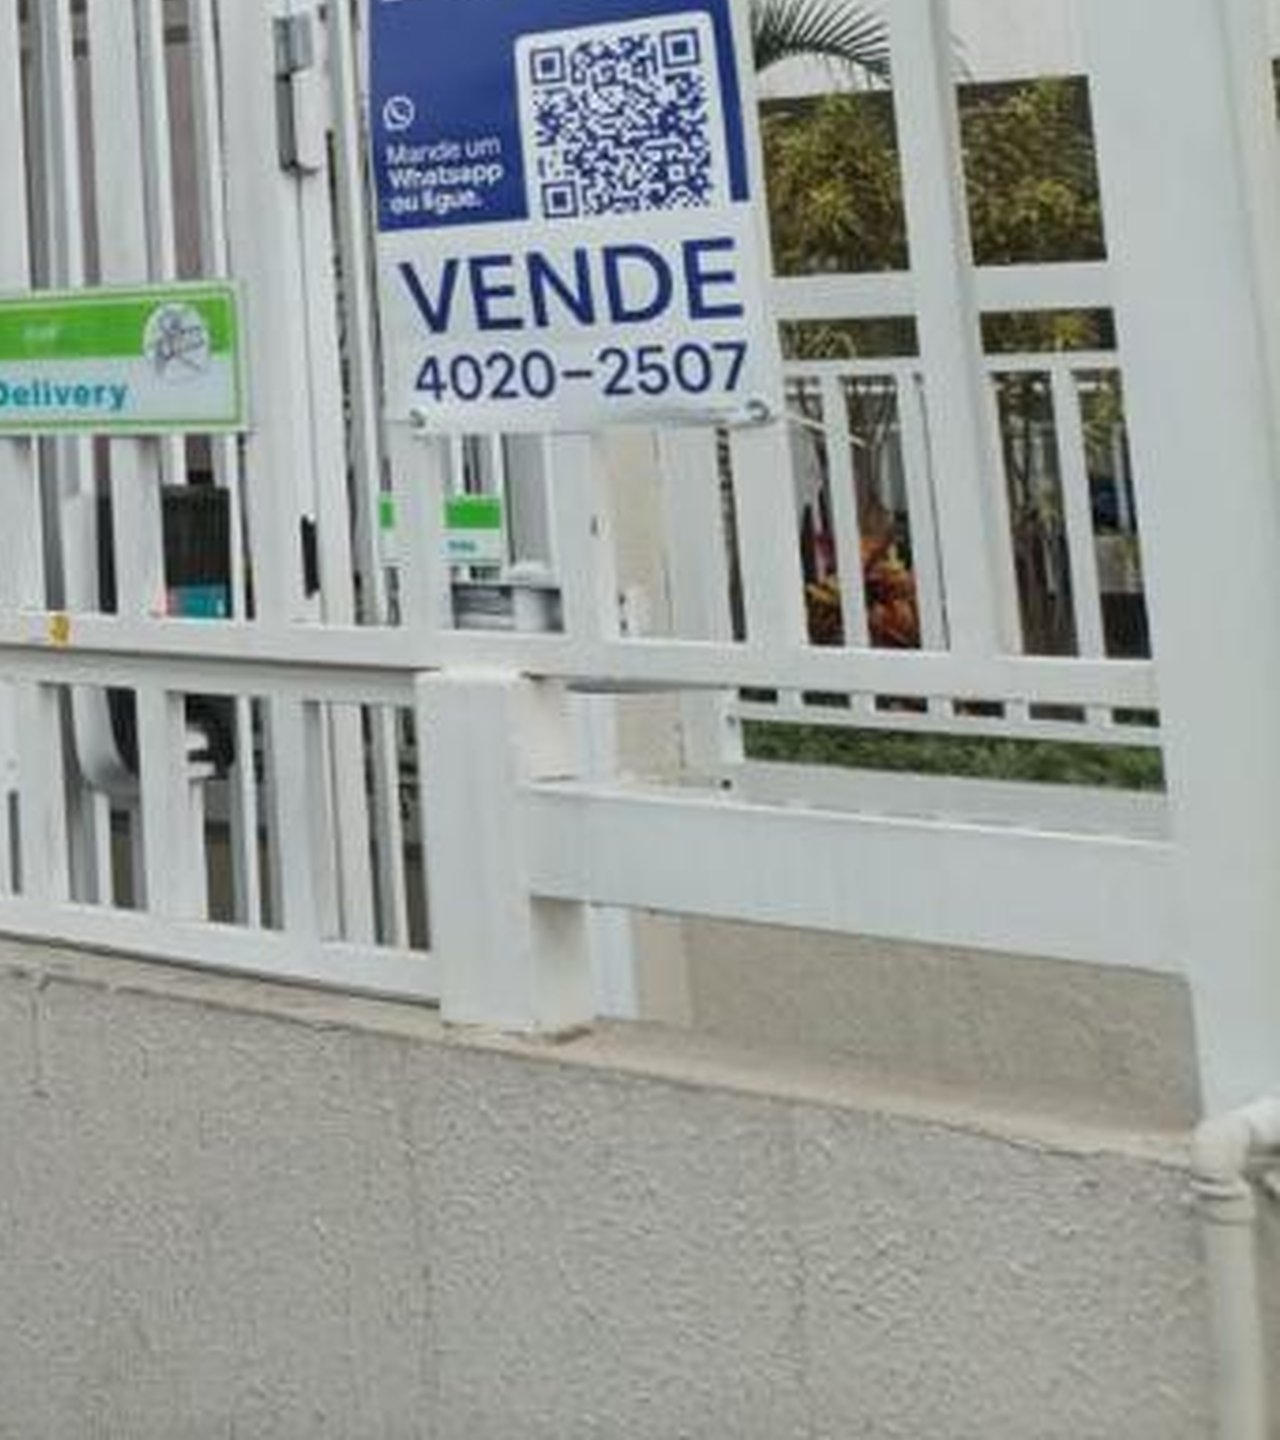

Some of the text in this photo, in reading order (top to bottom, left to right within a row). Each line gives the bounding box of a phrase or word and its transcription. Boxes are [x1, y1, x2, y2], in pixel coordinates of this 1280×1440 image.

[465, 137, 501, 158] um
[399, 237, 742, 334] VENDE
[415, 341, 747, 402] 4020-2507
